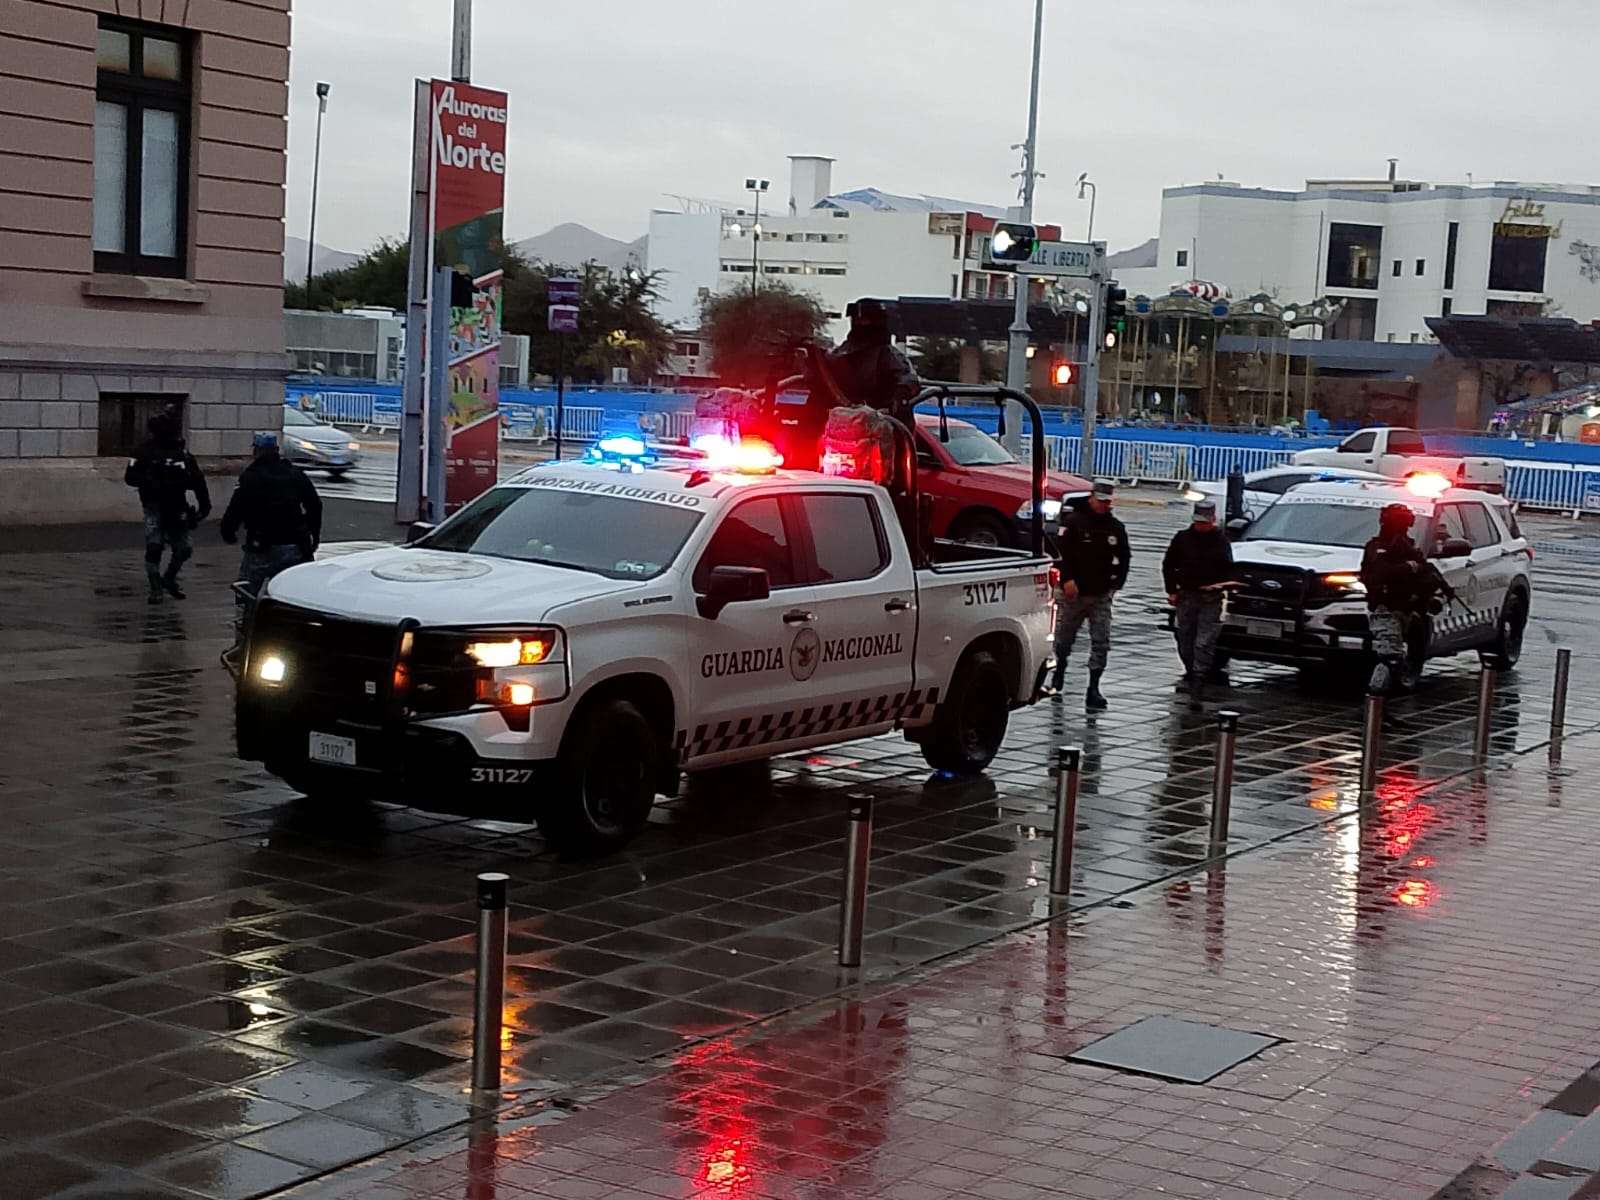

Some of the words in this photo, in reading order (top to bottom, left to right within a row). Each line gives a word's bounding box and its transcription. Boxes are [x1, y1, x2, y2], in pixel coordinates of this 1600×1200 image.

[438, 86, 506, 123] Auroras
[458, 122, 477, 138] del
[433, 115, 505, 174] Norte
[1053, 250, 1091, 268] LIBERTAD
[963, 581, 1007, 606] 31127
[701, 647, 785, 678] GUARDIA
[822, 633, 903, 663] NACIONAL
[320, 742, 344, 758] 31127
[471, 768, 534, 783] 31127
